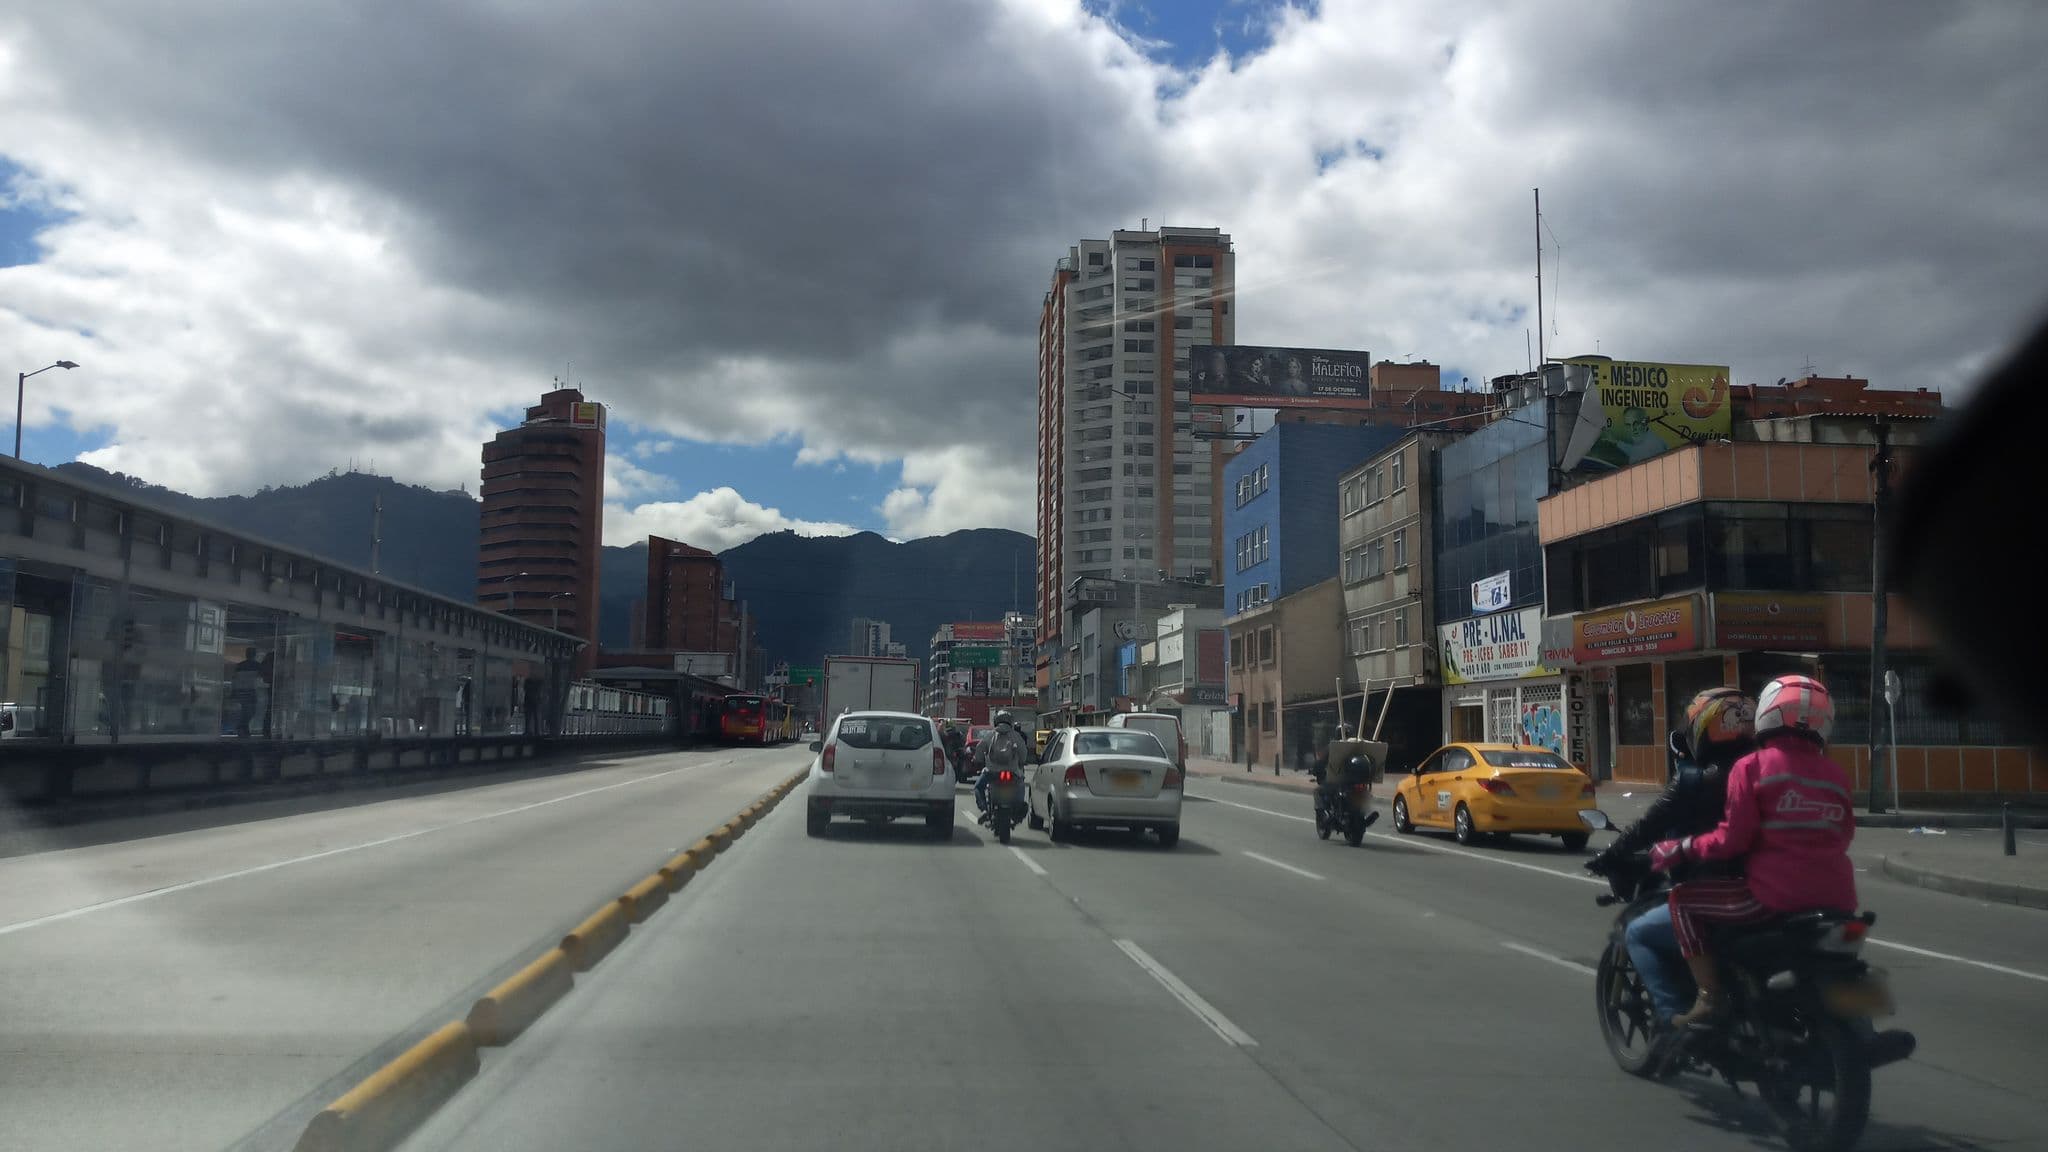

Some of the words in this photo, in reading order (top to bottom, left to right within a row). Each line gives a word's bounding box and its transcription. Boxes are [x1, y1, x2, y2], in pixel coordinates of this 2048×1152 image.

[1610, 362, 1668, 389] MÉDICO
[1601, 388, 1669, 409] INGENIERO
[1569, 675, 1586, 763] PLOTTER
